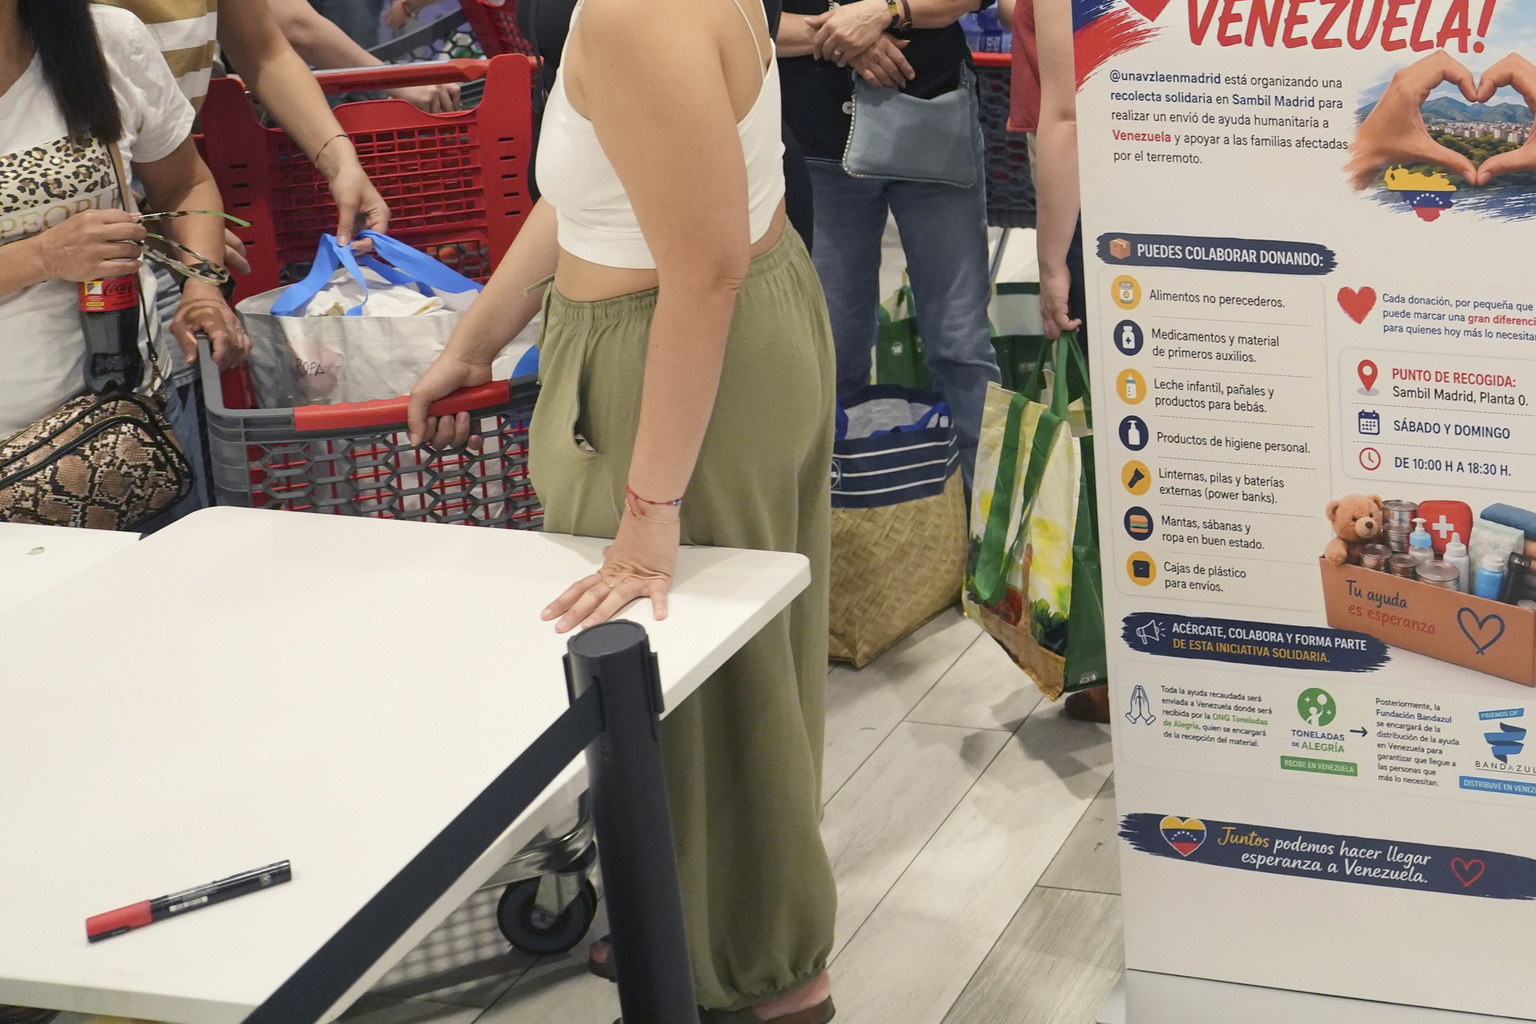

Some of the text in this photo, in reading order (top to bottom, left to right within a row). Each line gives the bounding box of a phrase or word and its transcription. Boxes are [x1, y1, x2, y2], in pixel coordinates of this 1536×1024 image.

[1110, 70, 1342, 88] @unavzlaenmadrid está organizando una
[1110, 91, 1342, 110] recolecta solidaria en Sambil Madrid para
[1112, 110, 1329, 128] realizar un envió de ayuda humanitaría a
[1112, 130, 1348, 150] Venezuela y apoyar a las familias afectadas
[1114, 151, 1202, 164] por el terremoto.
[1137, 244, 1323, 267] PUEDES COLABORAR DONANDO:
[1150, 290, 1285, 307] Alimentos no perecederos.
[1152, 329, 1279, 346] Medicamentos y material
[1152, 346, 1256, 363] de primeros auxilios.
[1392, 368, 1516, 387] PUNTO DE RECOGIDA:
[1154, 379, 1274, 399] Leche infantil, pañales y
[1393, 386, 1430, 399] Sambil
[1434, 389, 1476, 403] Madrid,
[1480, 392, 1514, 405] Planta
[1155, 396, 1205, 408] productos
[1209, 400, 1231, 410] para
[1394, 418, 1510, 439] SÁBADO Y DOMINGO
[1395, 457, 1511, 476] DE 10:00 H A 18:30 H.
[1164, 562, 1246, 578] Cajas de plástico
[1165, 578, 1186, 590] para
[1346, 580, 1407, 609] Tu ayuda
[1348, 605, 1436, 635] es esperanza
[1172, 623, 1367, 650] ACÉRCATE, COLABORA Y FORMA PARTE
[1173, 639, 1330, 663] DE ESTA INICIATIVA SOLIDARIA.
[1291, 729, 1344, 741] TONELADAS
[1301, 741, 1345, 753] ALEGRÍA
[1284, 760, 1305, 769] RECIBE
[1318, 763, 1354, 773] VENEZUELA
[1218, 827, 1431, 867] Juntos podemos hacer llegar
[1241, 852, 1428, 883] esperanza a Venezuela.
